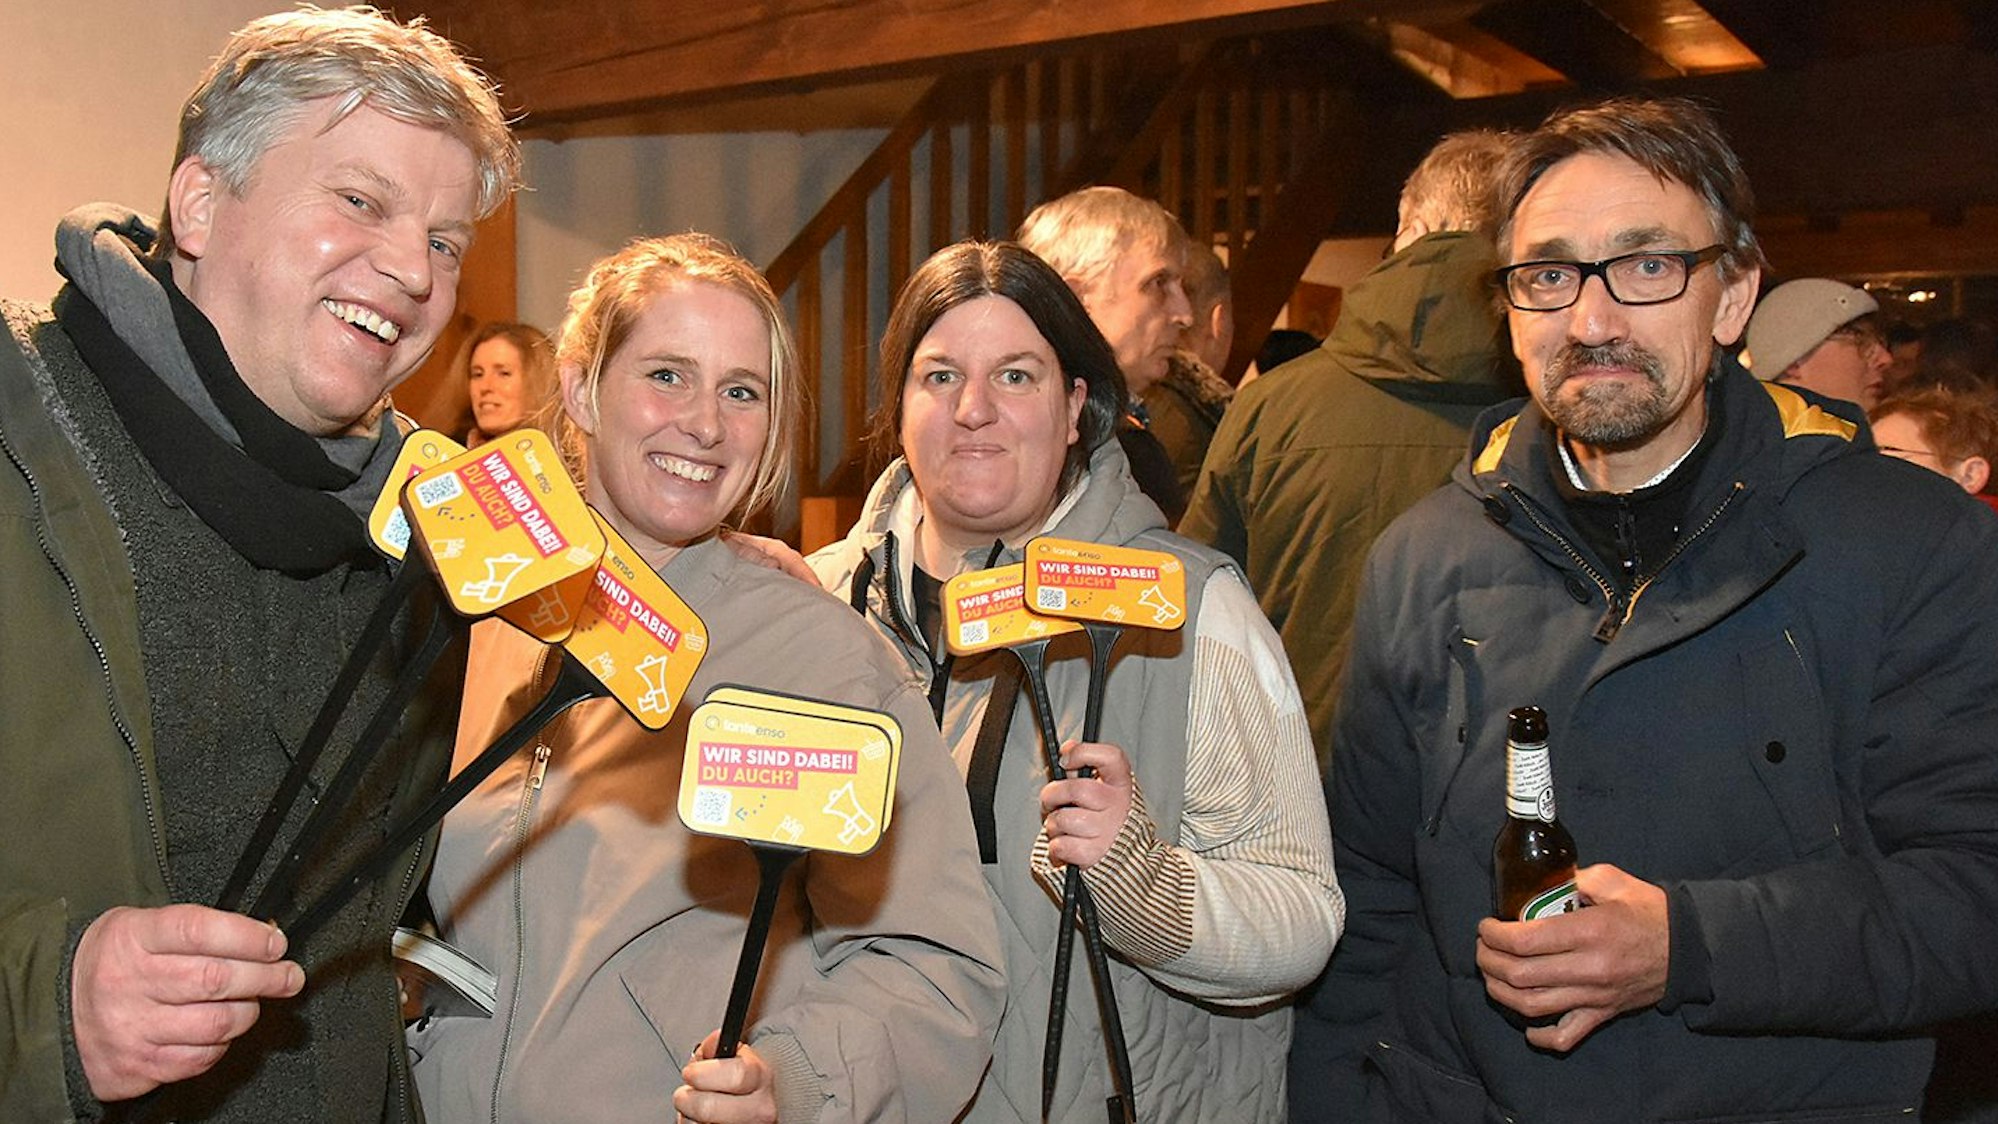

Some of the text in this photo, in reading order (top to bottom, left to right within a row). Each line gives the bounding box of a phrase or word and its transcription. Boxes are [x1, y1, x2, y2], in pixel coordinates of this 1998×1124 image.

[463, 464, 515, 525] DU AUCH?
[482, 453, 563, 554] WIR SIND DABEI!
[1039, 562, 1156, 580] WIR SIND DABEI!
[1041, 574, 1112, 588] DU AUCH?
[595, 570, 677, 647] SIND DABEI!
[960, 585, 1024, 609] WIR SIND
[961, 596, 1024, 620] DU AUCH
[702, 746, 853, 771] WIR SIND DABEI!
[702, 765, 795, 785] DU AUCH?
